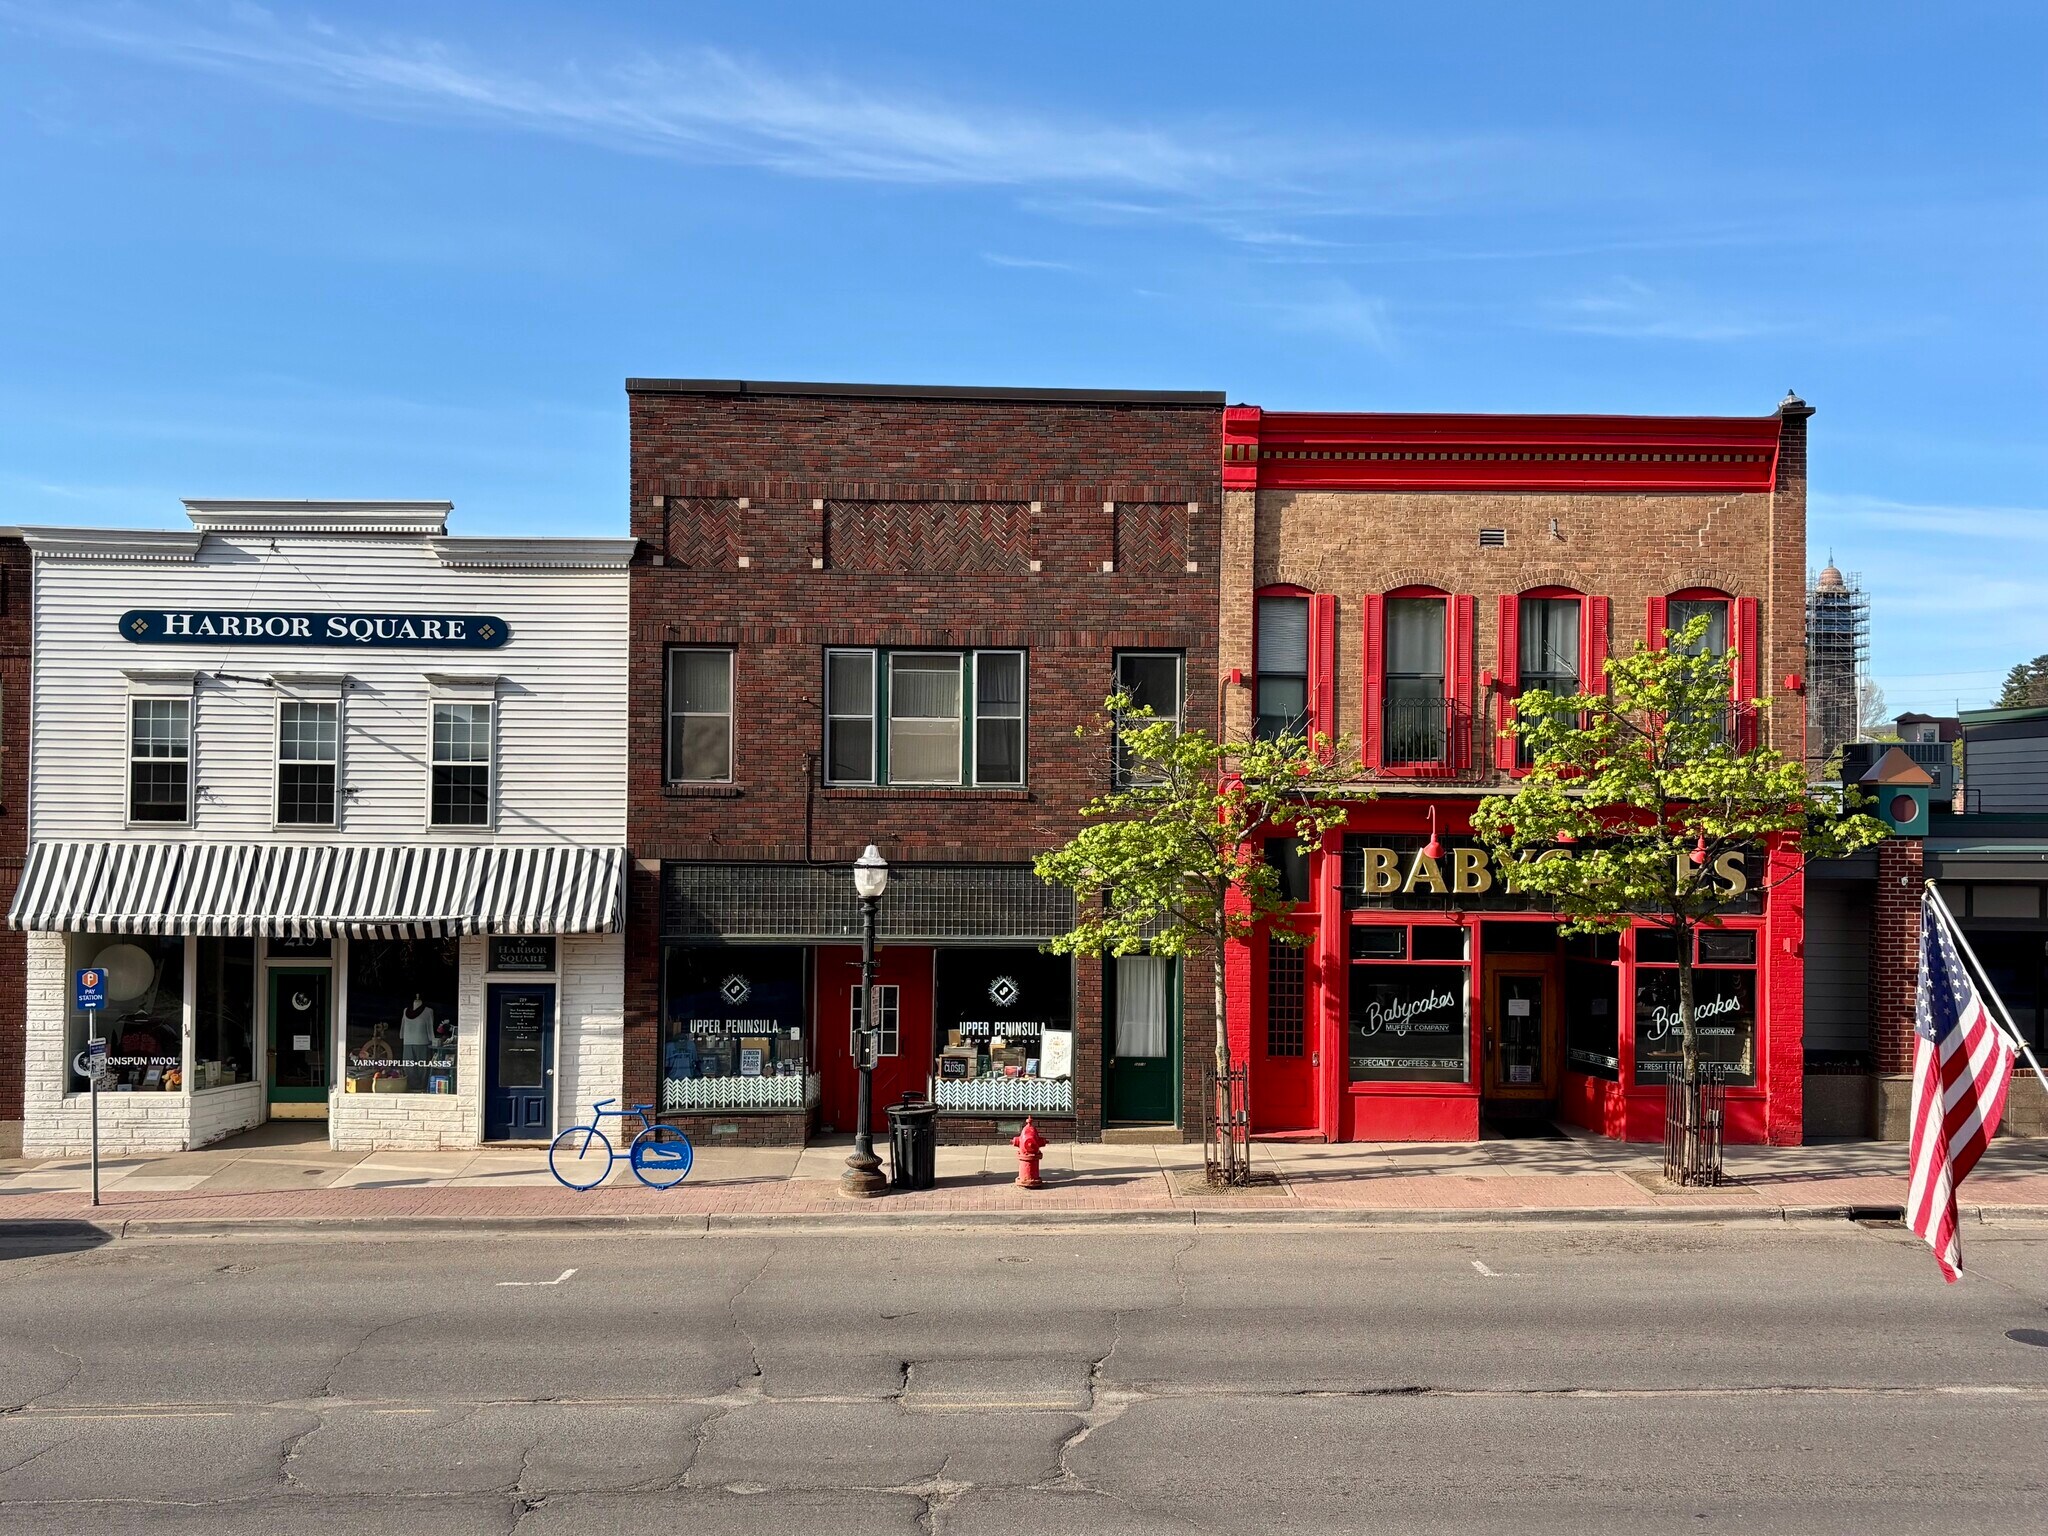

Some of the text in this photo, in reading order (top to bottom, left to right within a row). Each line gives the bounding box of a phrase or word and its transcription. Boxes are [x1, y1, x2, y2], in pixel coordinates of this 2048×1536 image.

[1361, 989, 1455, 1037] Babycakes
[689, 1019, 779, 1034] UPPER PENINSULA
[959, 1021, 1047, 1036] UPPER PENINSULA
[1385, 1023, 1412, 1031] MUFFIN
[105, 1056, 148, 1066] ONSPUN
[150, 1056, 179, 1066] WOOL
[1358, 1059, 1396, 1067] SPECIALTY
[1440, 1060, 1458, 1068] TEAS
[944, 1063, 966, 1073] CLOSED
[1643, 1063, 1663, 1071] FRESH
